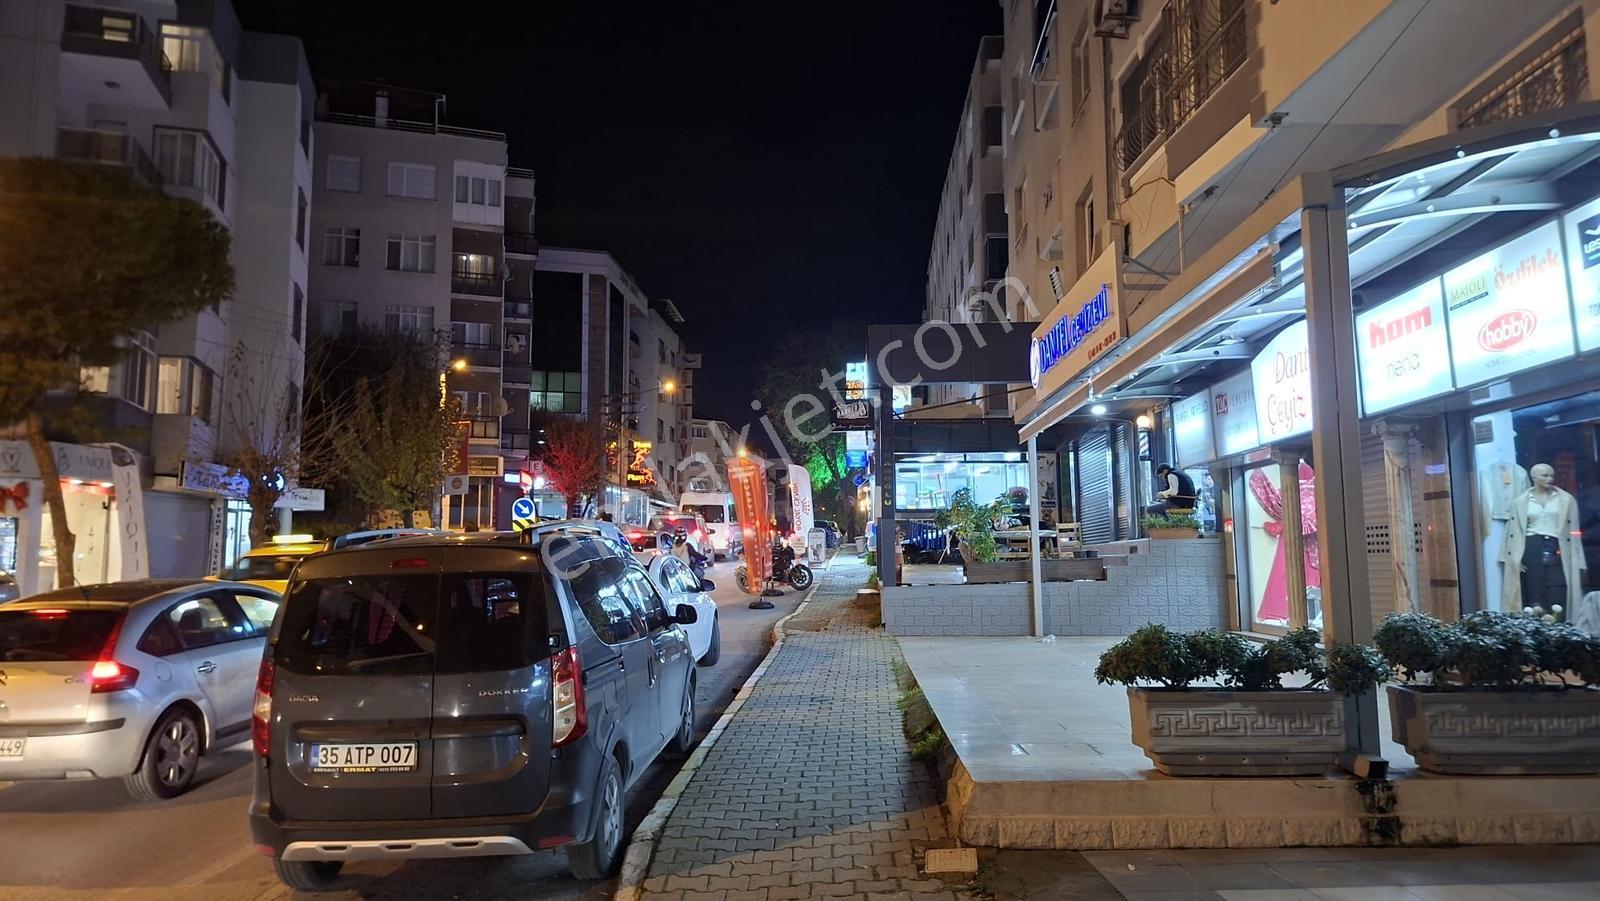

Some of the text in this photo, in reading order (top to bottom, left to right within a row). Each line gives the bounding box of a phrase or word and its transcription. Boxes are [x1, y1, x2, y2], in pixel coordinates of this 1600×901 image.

[1039, 314, 1072, 374] DANTEL
[1486, 316, 1531, 346] hobby
[1268, 388, 1306, 435] Çeyiz
[320, 745, 413, 765] 35 ATP 007
